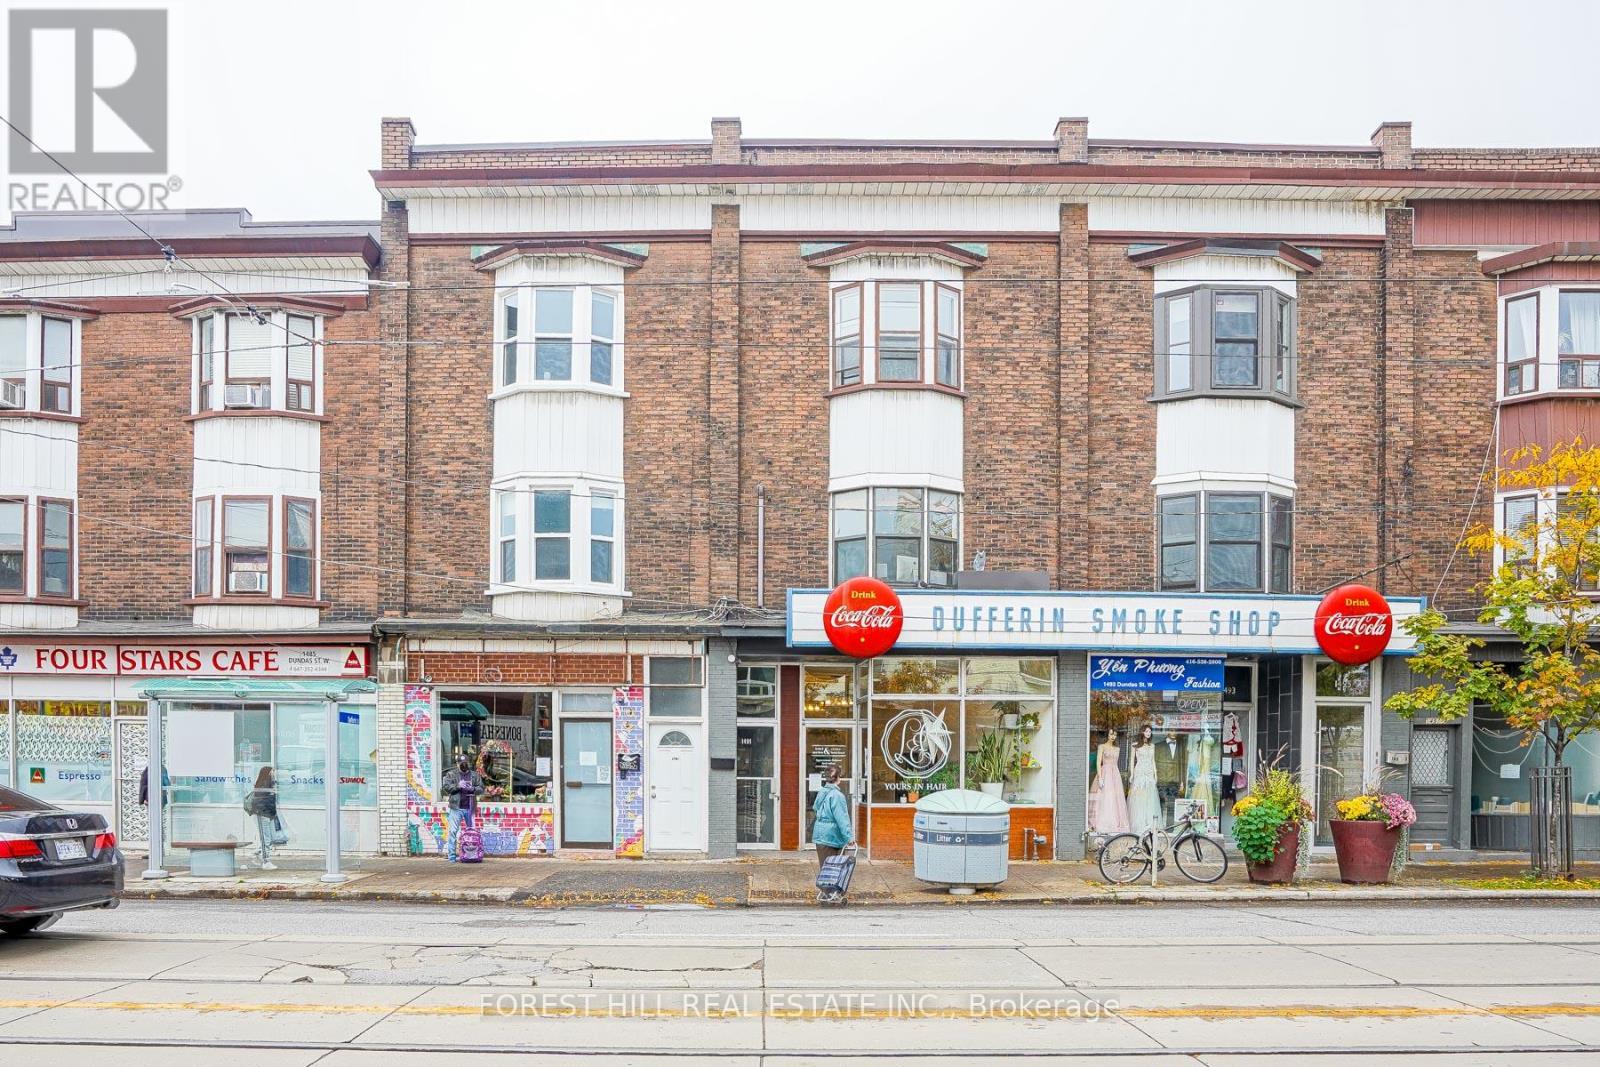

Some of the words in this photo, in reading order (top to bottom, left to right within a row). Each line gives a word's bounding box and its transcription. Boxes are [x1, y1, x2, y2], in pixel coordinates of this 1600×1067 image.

[851, 591, 877, 599] Drink
[1345, 598, 1370, 607] Drink
[830, 604, 897, 628] Coca-Cola
[932, 605, 1065, 633] DUFFERIN
[1092, 607, 1184, 635] SMOKE
[1209, 609, 1281, 637] SHOP
[1324, 612, 1388, 636] Coca-Cola
[35, 648, 108, 670] FOUR
[120, 649, 202, 671] STARS
[1183, 676, 1222, 689] Fashion
[58, 770, 101, 782] Espresso
[290, 774, 325, 785] Snacks
[936, 833, 952, 842] Litter
